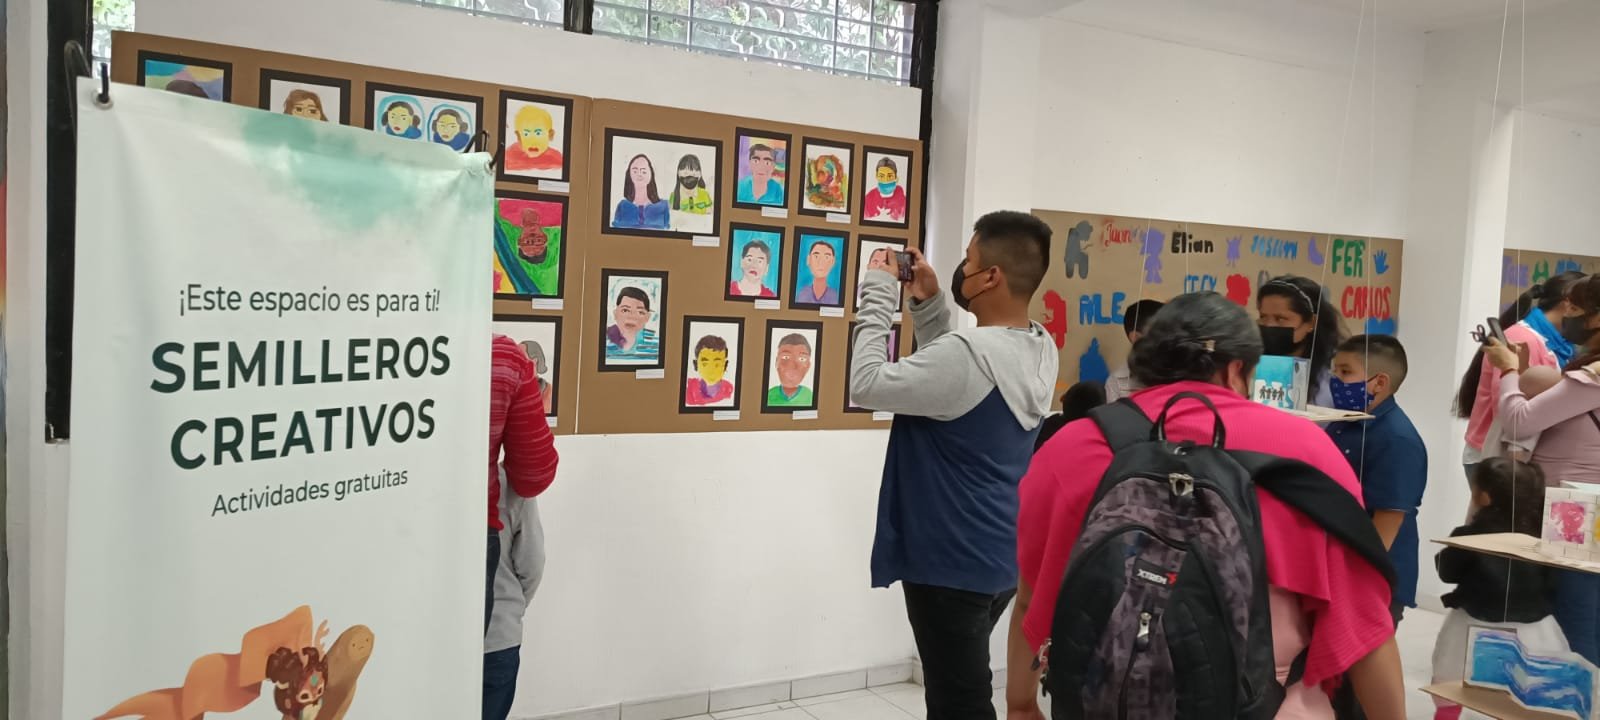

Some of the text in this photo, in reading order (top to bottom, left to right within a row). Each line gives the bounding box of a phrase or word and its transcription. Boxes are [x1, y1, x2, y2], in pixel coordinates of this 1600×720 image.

[1171, 231, 1214, 253] Elian
[1332, 238, 1365, 278] FER
[179, 283, 441, 318] ¡Este espacio es para ti!
[1079, 292, 1126, 325] ALE
[1341, 285, 1391, 320] CARLOS
[150, 336, 451, 394] SEMILLEROS
[170, 398, 436, 470] CREATIVOS
[211, 467, 408, 518] Actividades gratuitas
